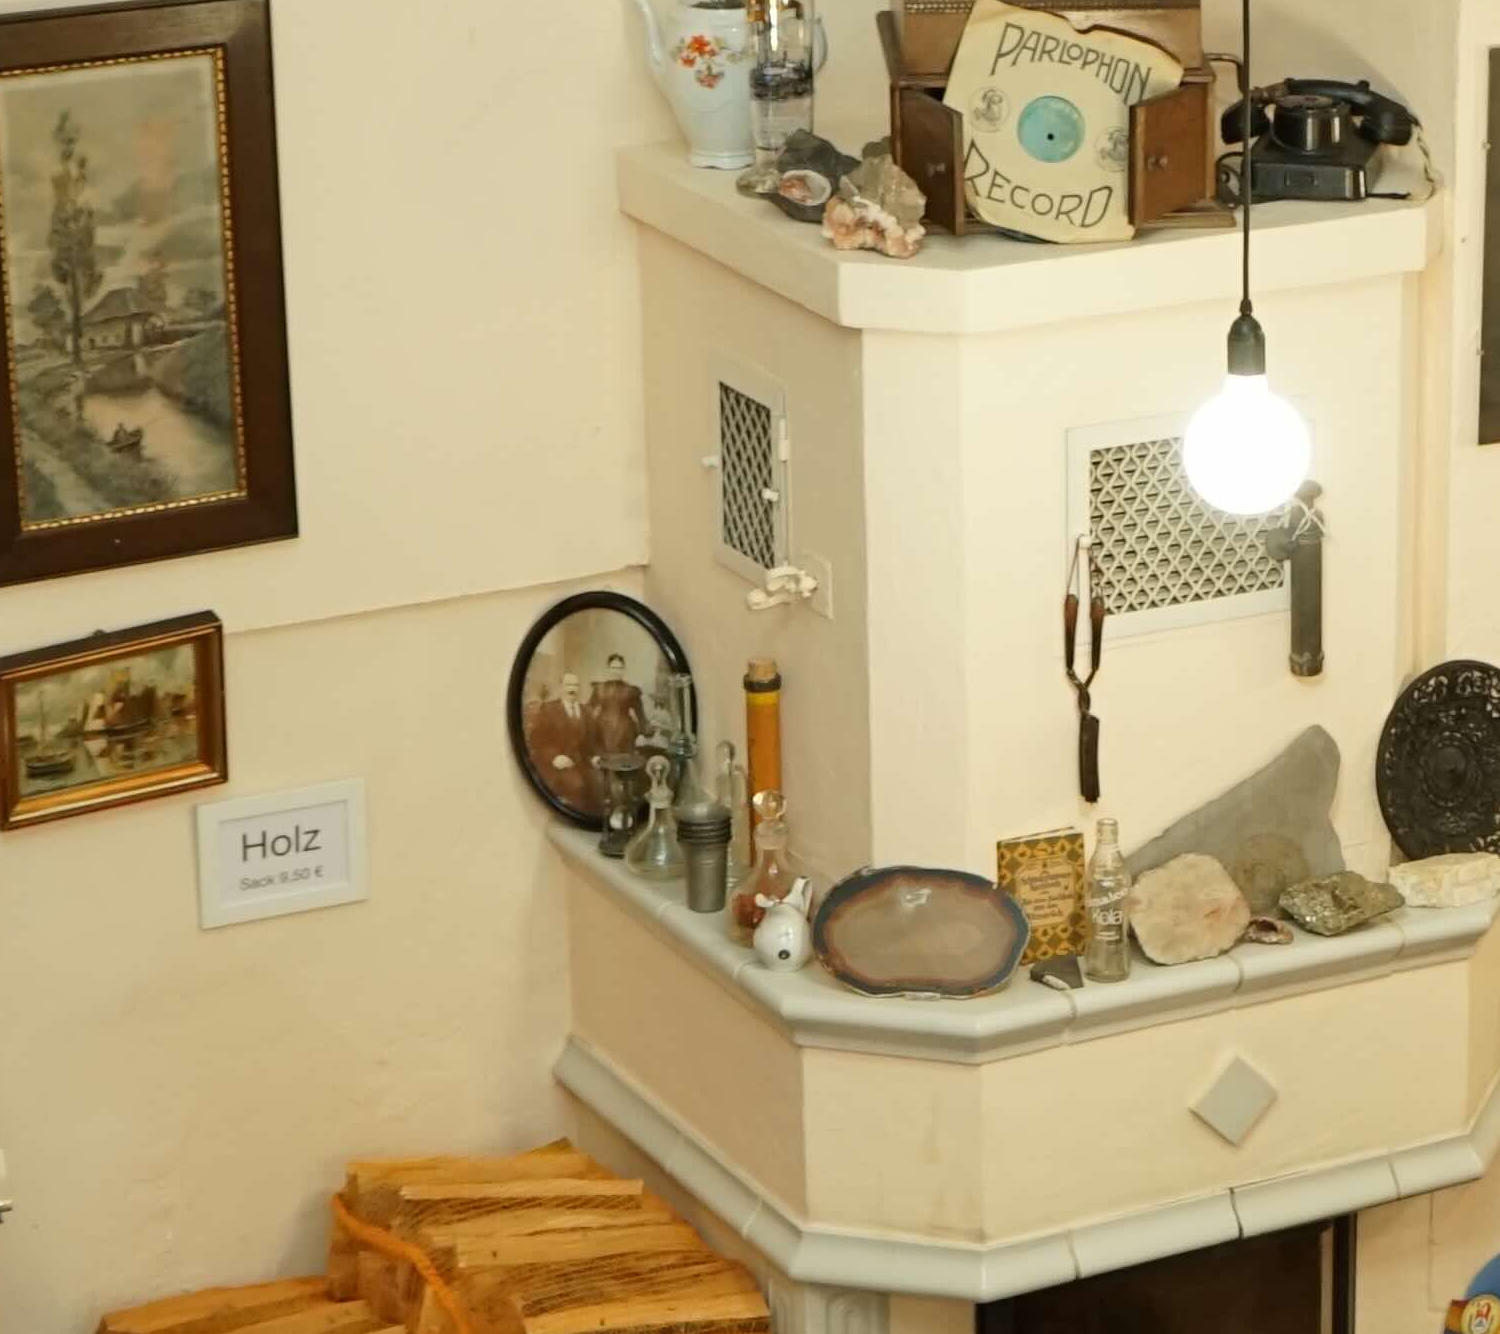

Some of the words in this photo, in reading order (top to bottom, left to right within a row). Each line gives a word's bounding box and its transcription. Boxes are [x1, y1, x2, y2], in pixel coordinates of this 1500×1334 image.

[990, 22, 1152, 107] PARLOPHON
[963, 138, 1114, 229] RECORD
[242, 824, 322, 862] Holz
